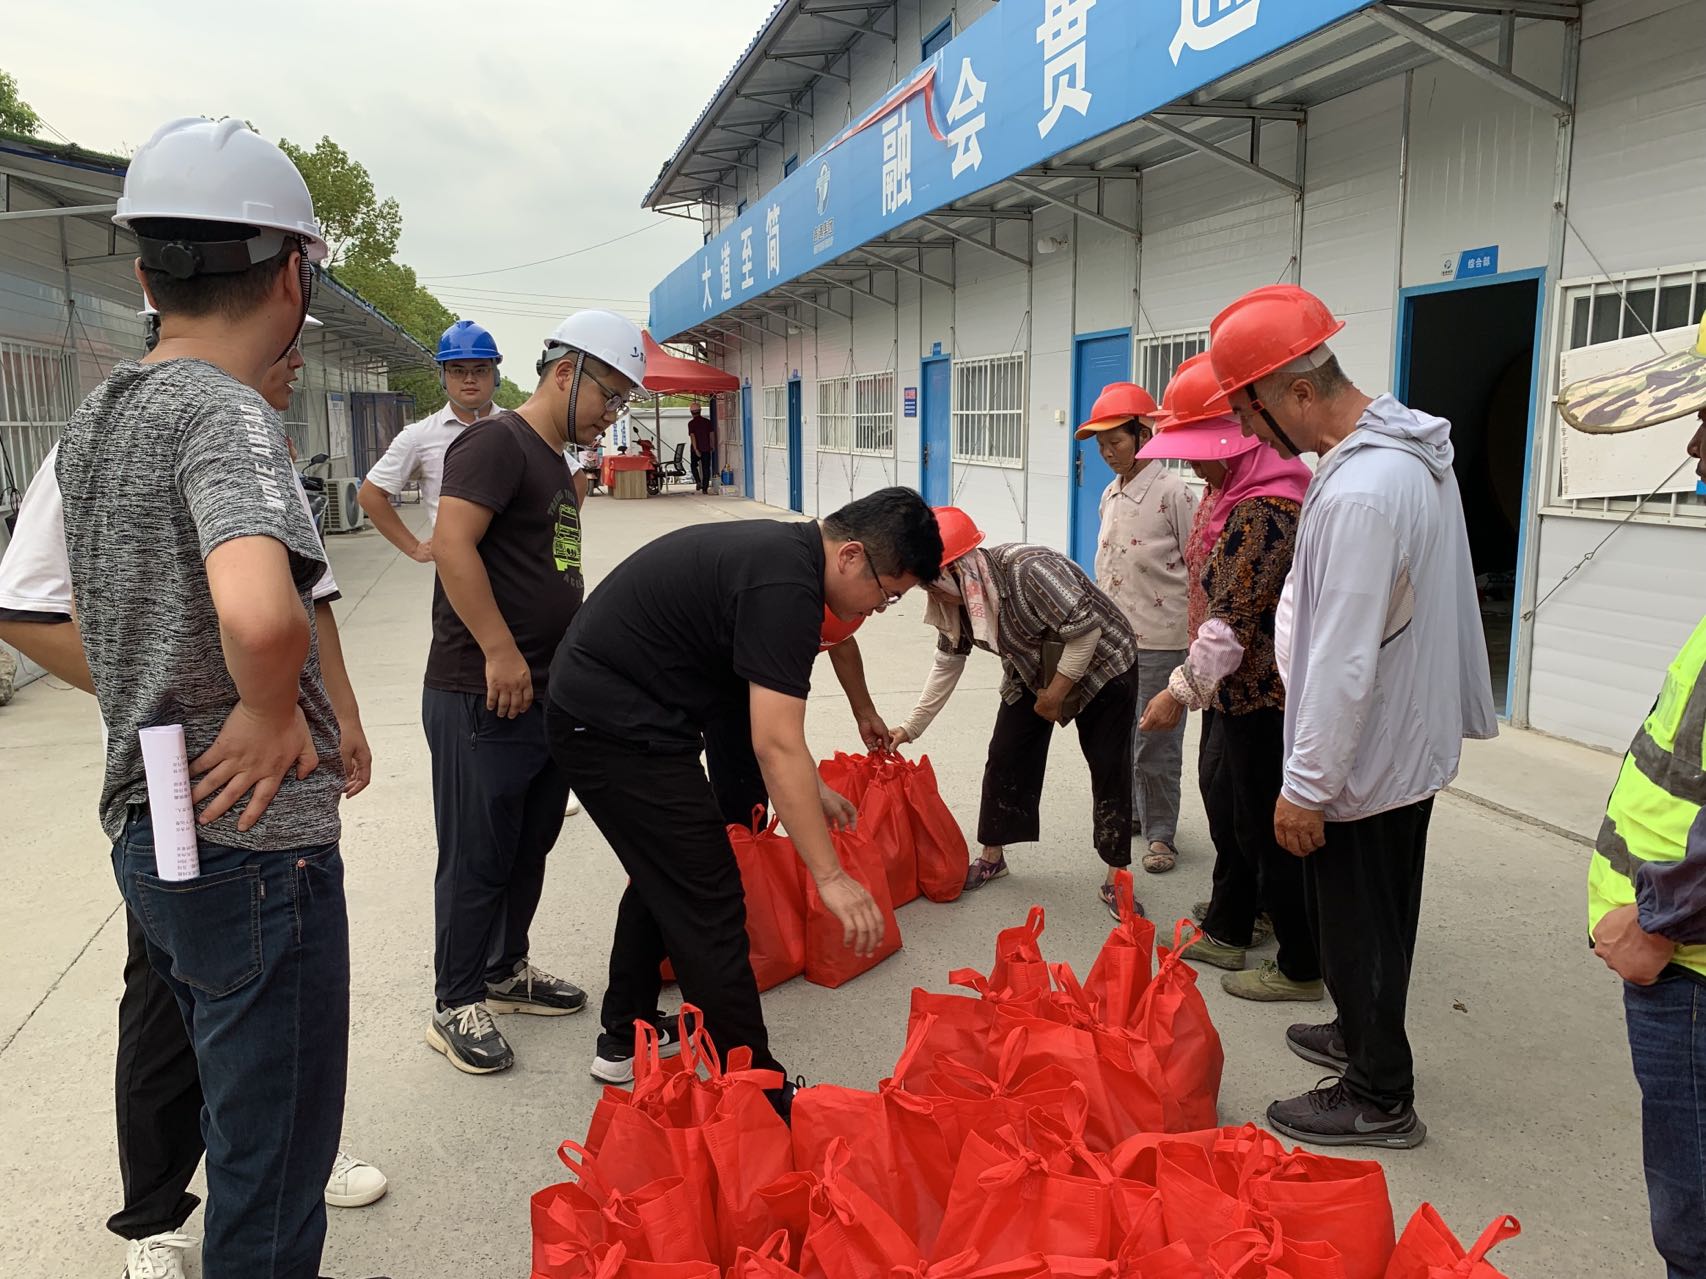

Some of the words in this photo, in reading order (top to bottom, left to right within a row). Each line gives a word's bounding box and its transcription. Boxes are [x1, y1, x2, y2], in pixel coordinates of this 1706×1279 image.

[702, 203, 781, 312] 大道至简
[1467, 256, 1491, 269] 综合部
[240, 404, 274, 459] AHEAD
[255, 462, 286, 512] MOVE
